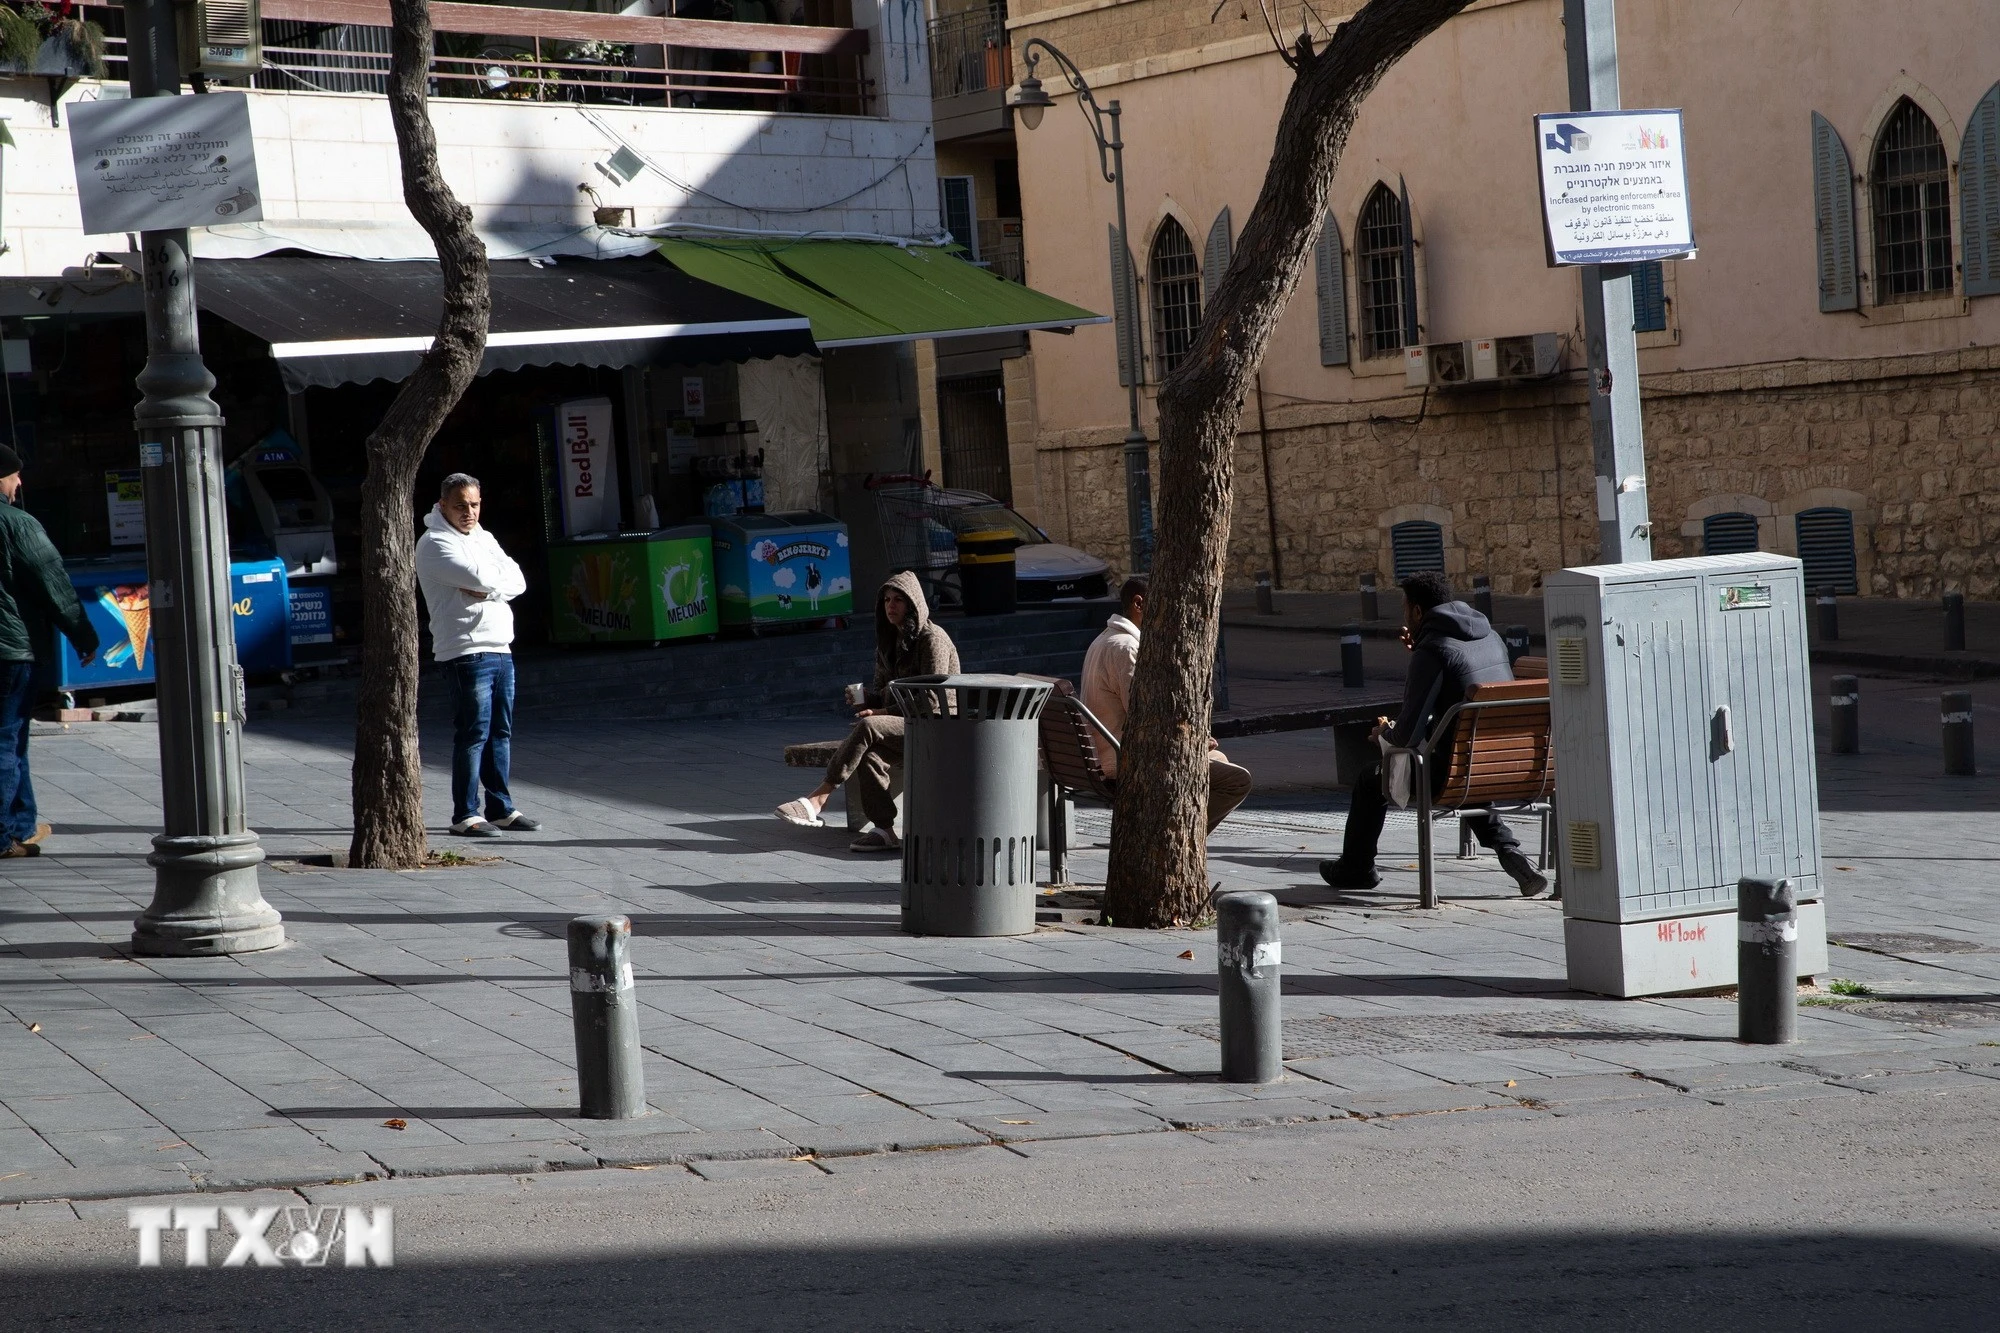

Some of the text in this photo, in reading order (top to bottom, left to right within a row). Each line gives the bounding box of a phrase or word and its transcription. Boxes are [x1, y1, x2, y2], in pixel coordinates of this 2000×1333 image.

[116, 130, 200, 144] אזור זה מצולם
[94, 146, 142, 157] מצלמות
[166, 142, 182, 152] על
[187, 140, 229, 152] ומוקלט
[116, 152, 210, 167] עיר ללא אלימות
[1554, 160, 1672, 174] איזור אכיפת חניה מוגברת
[1566, 176, 1662, 190] באמצעים אלקטרוניים
[1550, 194, 1588, 204] Increased
[1590, 194, 1619, 203] parking
[1620, 190, 1664, 200] enforcement
[1582, 206, 1592, 215] by
[1594, 204, 1630, 212] electronic
[1593, 216, 1612, 228] قانون
[1634, 215, 1654, 228] تخضع
[1656, 212, 1674, 222] منطقة
[1565, 218, 1591, 230] الوقوف
[264, 453, 284, 462] ATM
[568, 416, 593, 498] Red Bull
[667, 598, 708, 624] MELONA
[581, 608, 632, 631] MELONA
